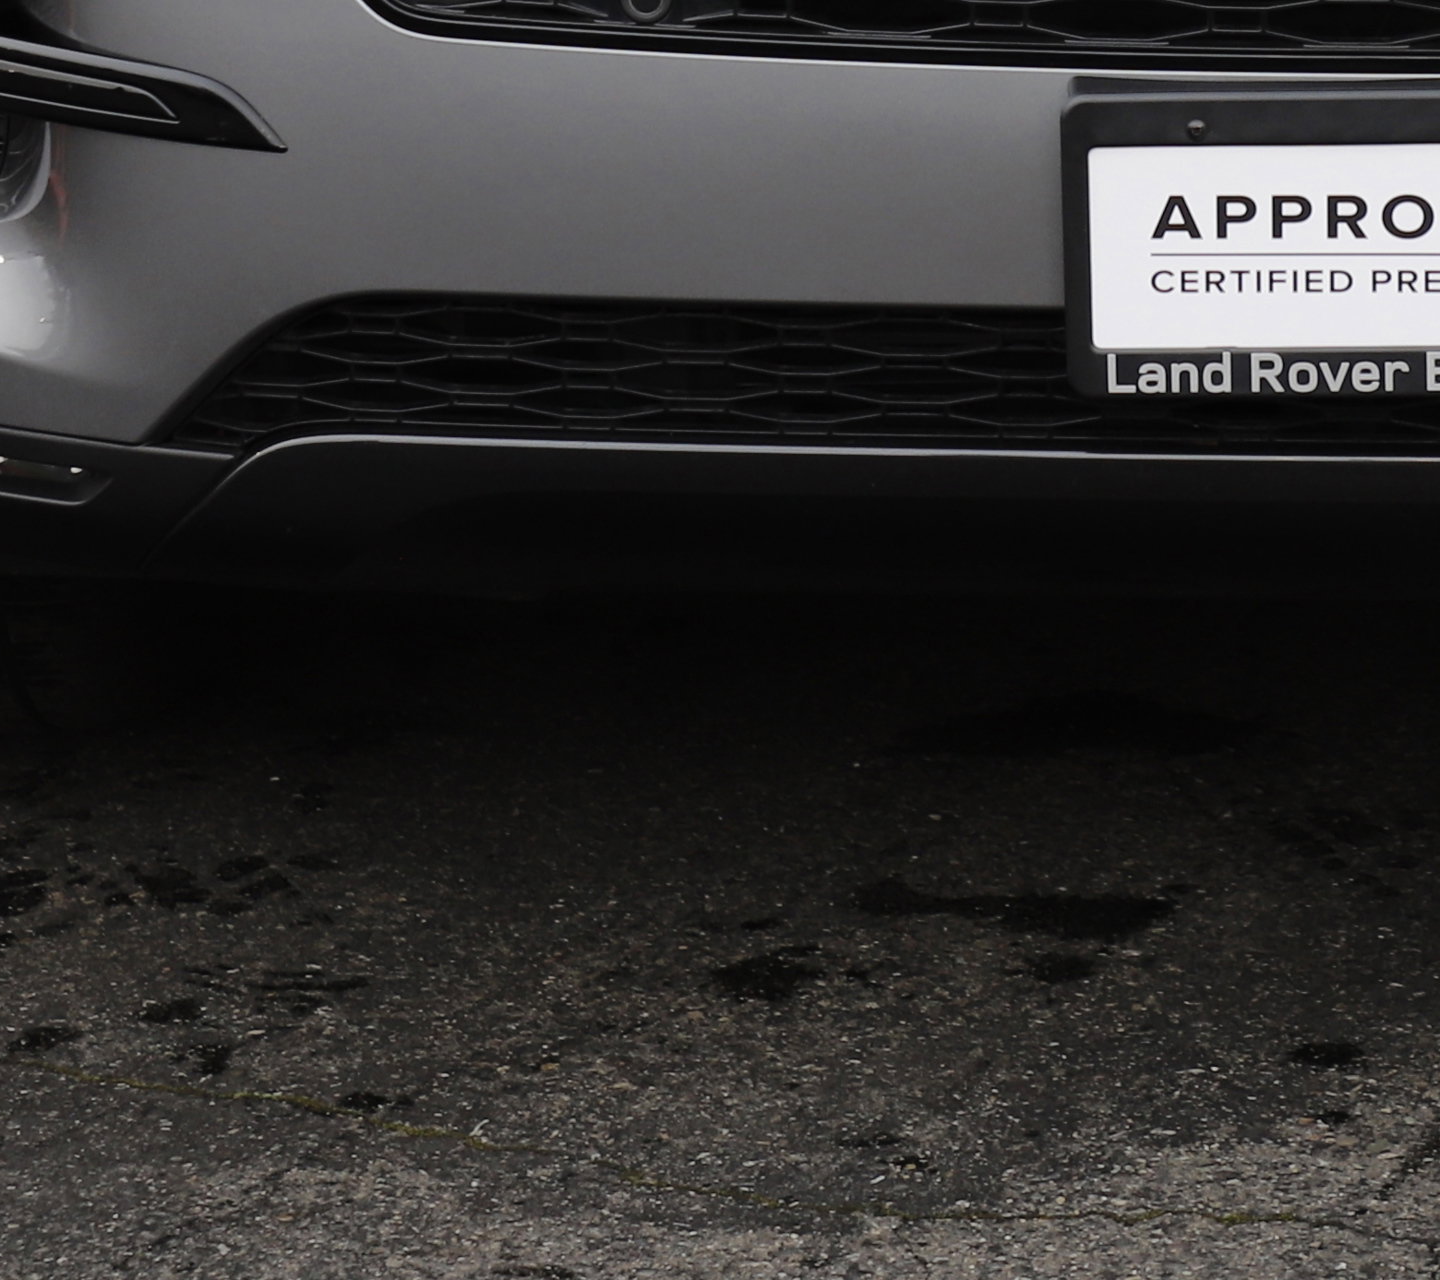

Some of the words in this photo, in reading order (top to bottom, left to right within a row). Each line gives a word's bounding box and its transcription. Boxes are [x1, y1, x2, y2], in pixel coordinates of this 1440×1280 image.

[1150, 269, 1354, 294] CERTIFIED
[1105, 350, 1233, 395] Land
[1250, 351, 1410, 394] Rover
